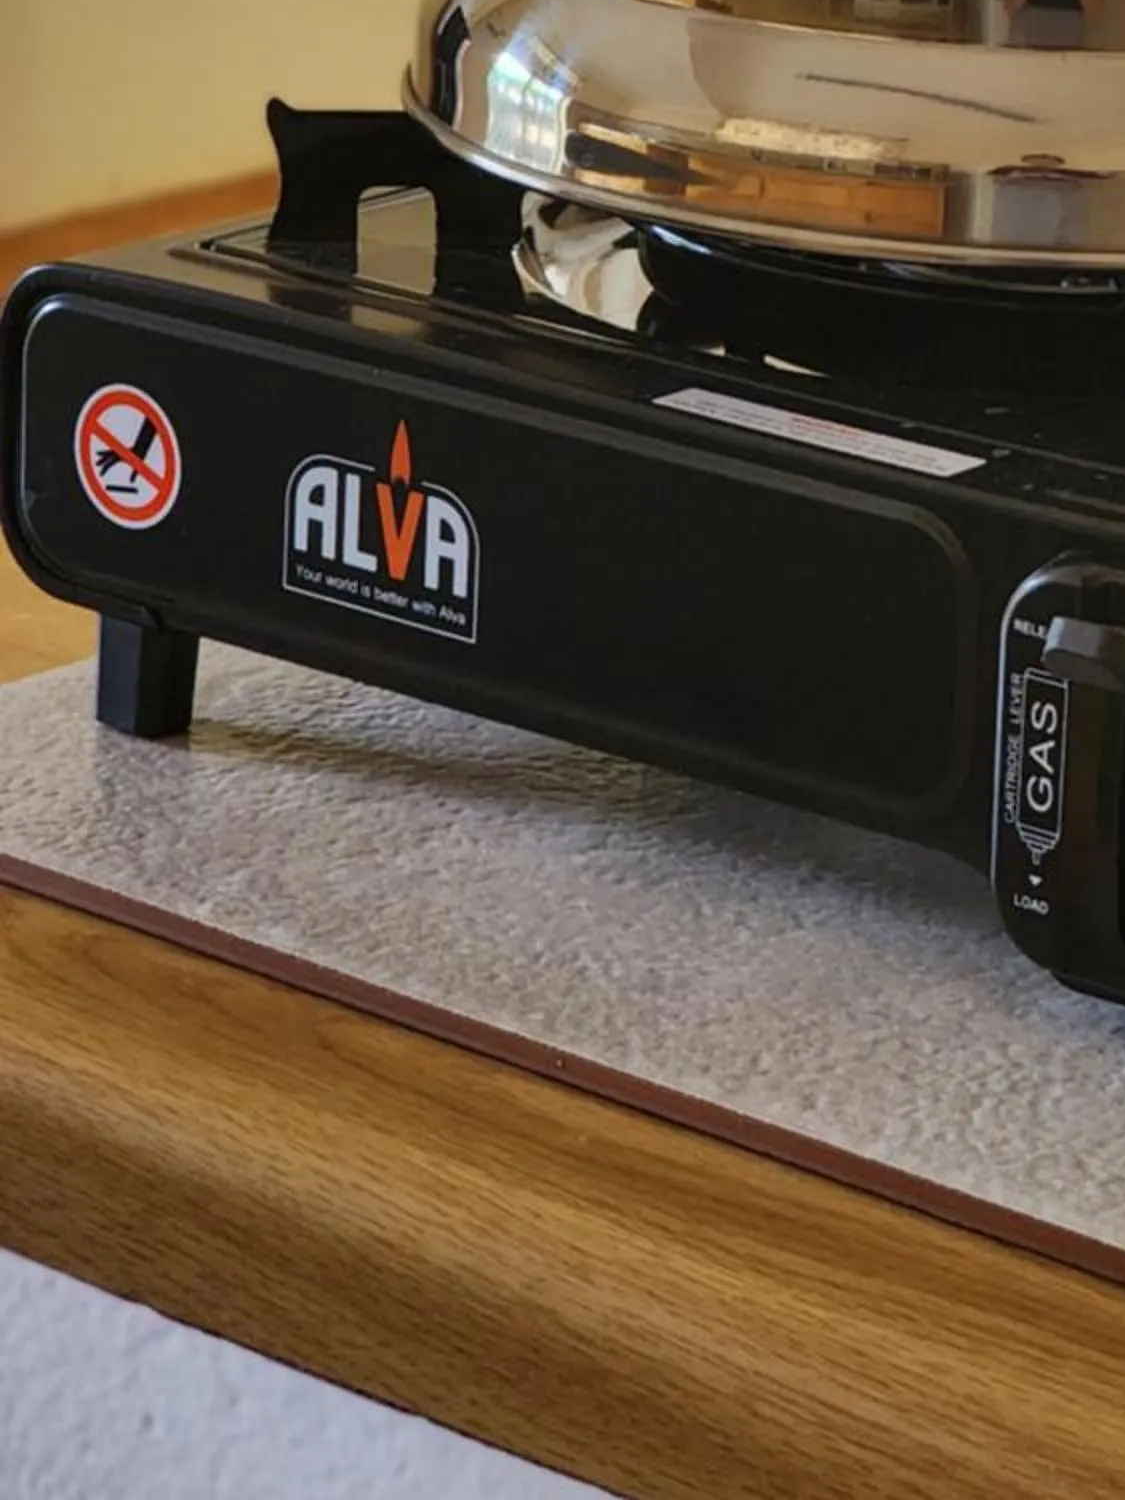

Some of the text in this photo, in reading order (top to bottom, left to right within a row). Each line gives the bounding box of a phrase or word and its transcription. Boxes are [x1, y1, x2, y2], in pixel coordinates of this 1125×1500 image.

[294, 465, 470, 599] ALVA
[296, 564, 467, 626] Your world is better with Alva
[1004, 672, 1023, 823] CARTRIDGE LEVER
[1026, 701, 1058, 813] GAS
[1013, 892, 1050, 916] LOAD
